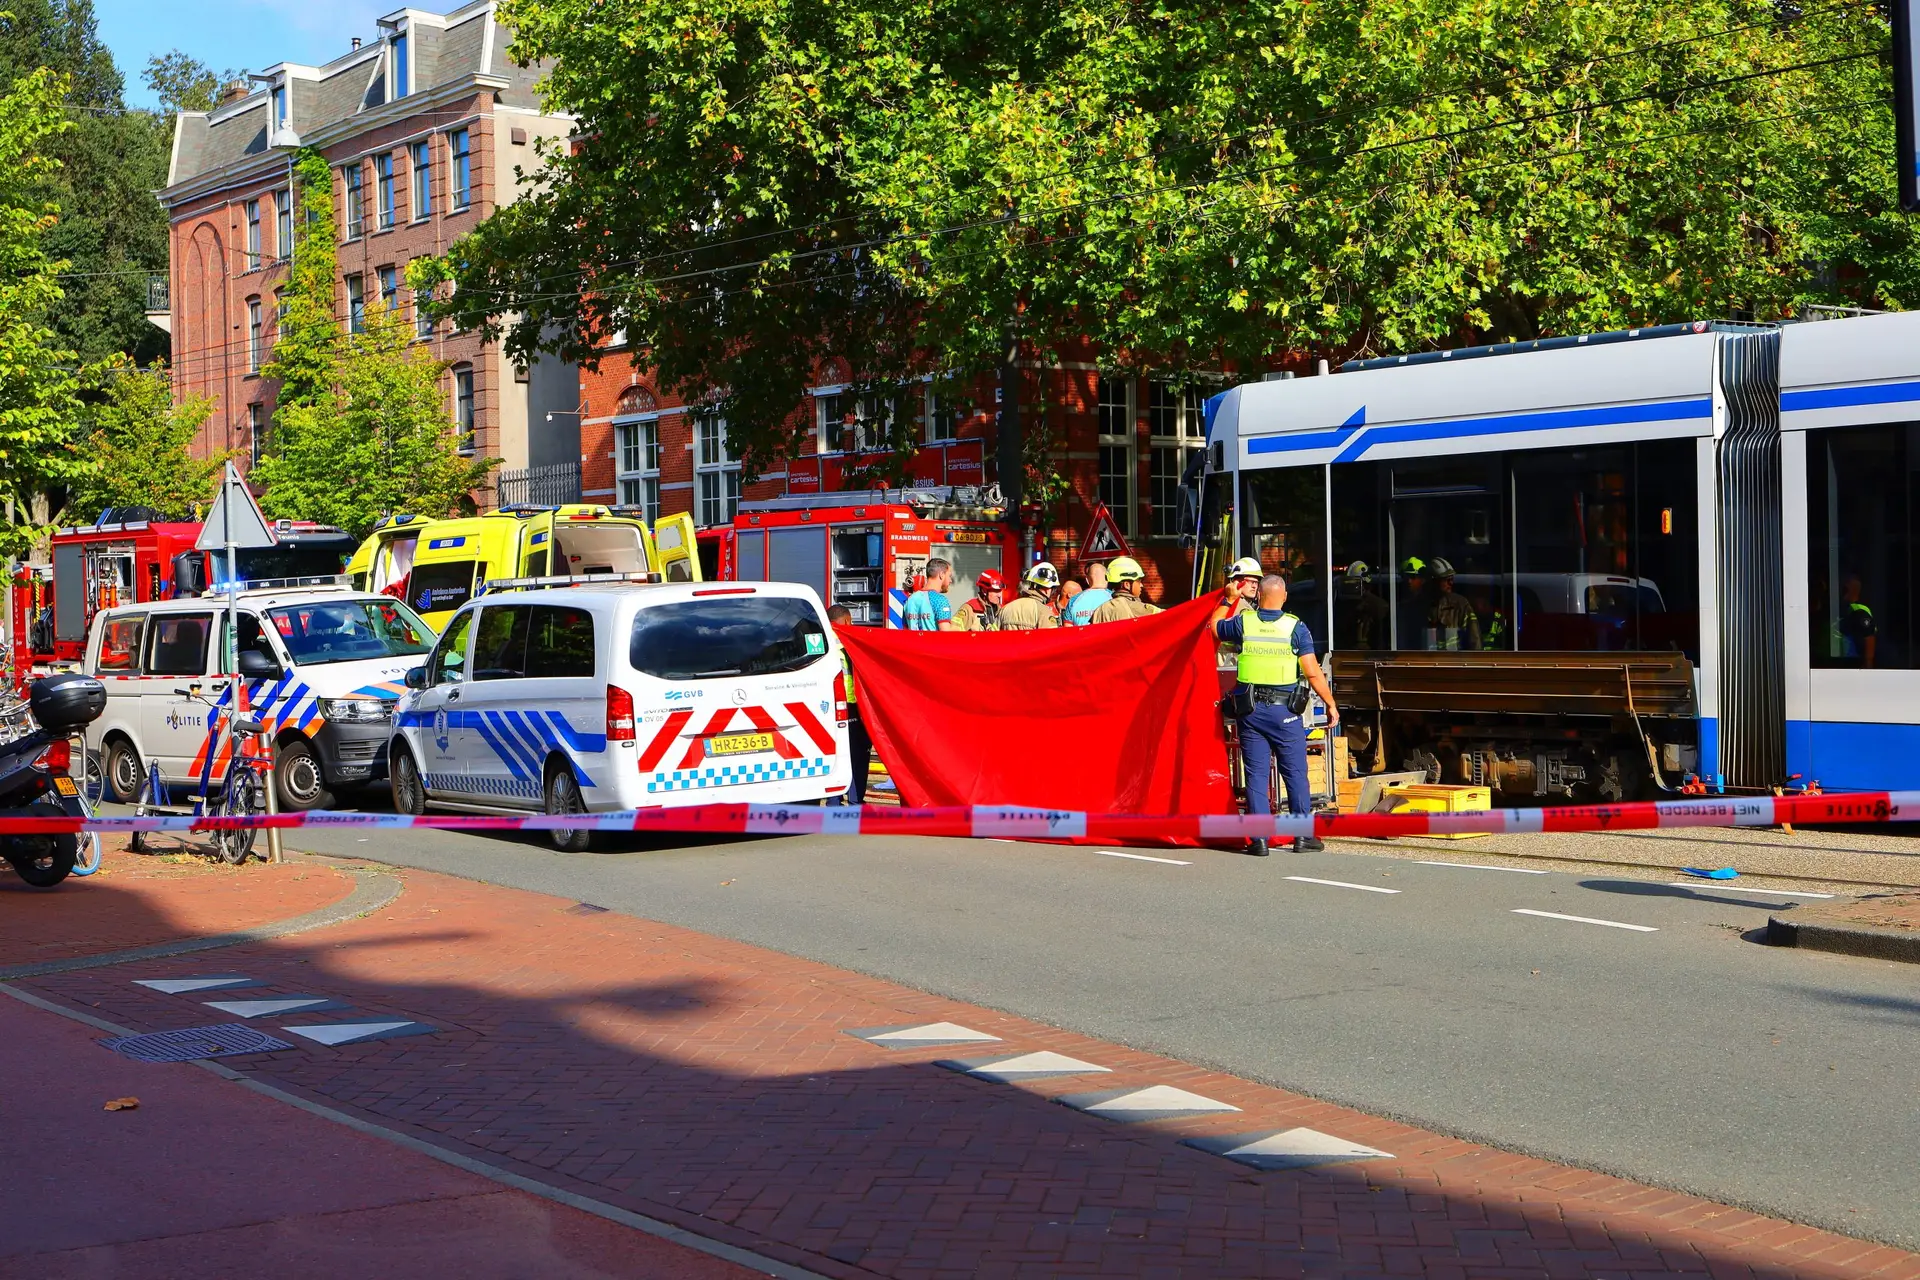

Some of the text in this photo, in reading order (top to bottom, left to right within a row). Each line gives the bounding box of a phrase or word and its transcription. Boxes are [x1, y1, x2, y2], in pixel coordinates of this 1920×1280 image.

[948, 462, 981, 471] cartesius
[790, 475, 818, 484] cartesius
[890, 534, 929, 542] BRANDWEER
[1243, 644, 1291, 656] HANDHAVING
[684, 689, 704, 699] GVB
[714, 736, 769, 751] HRZ-36-B
[1655, 804, 1761, 817] NIET BETREDEN
